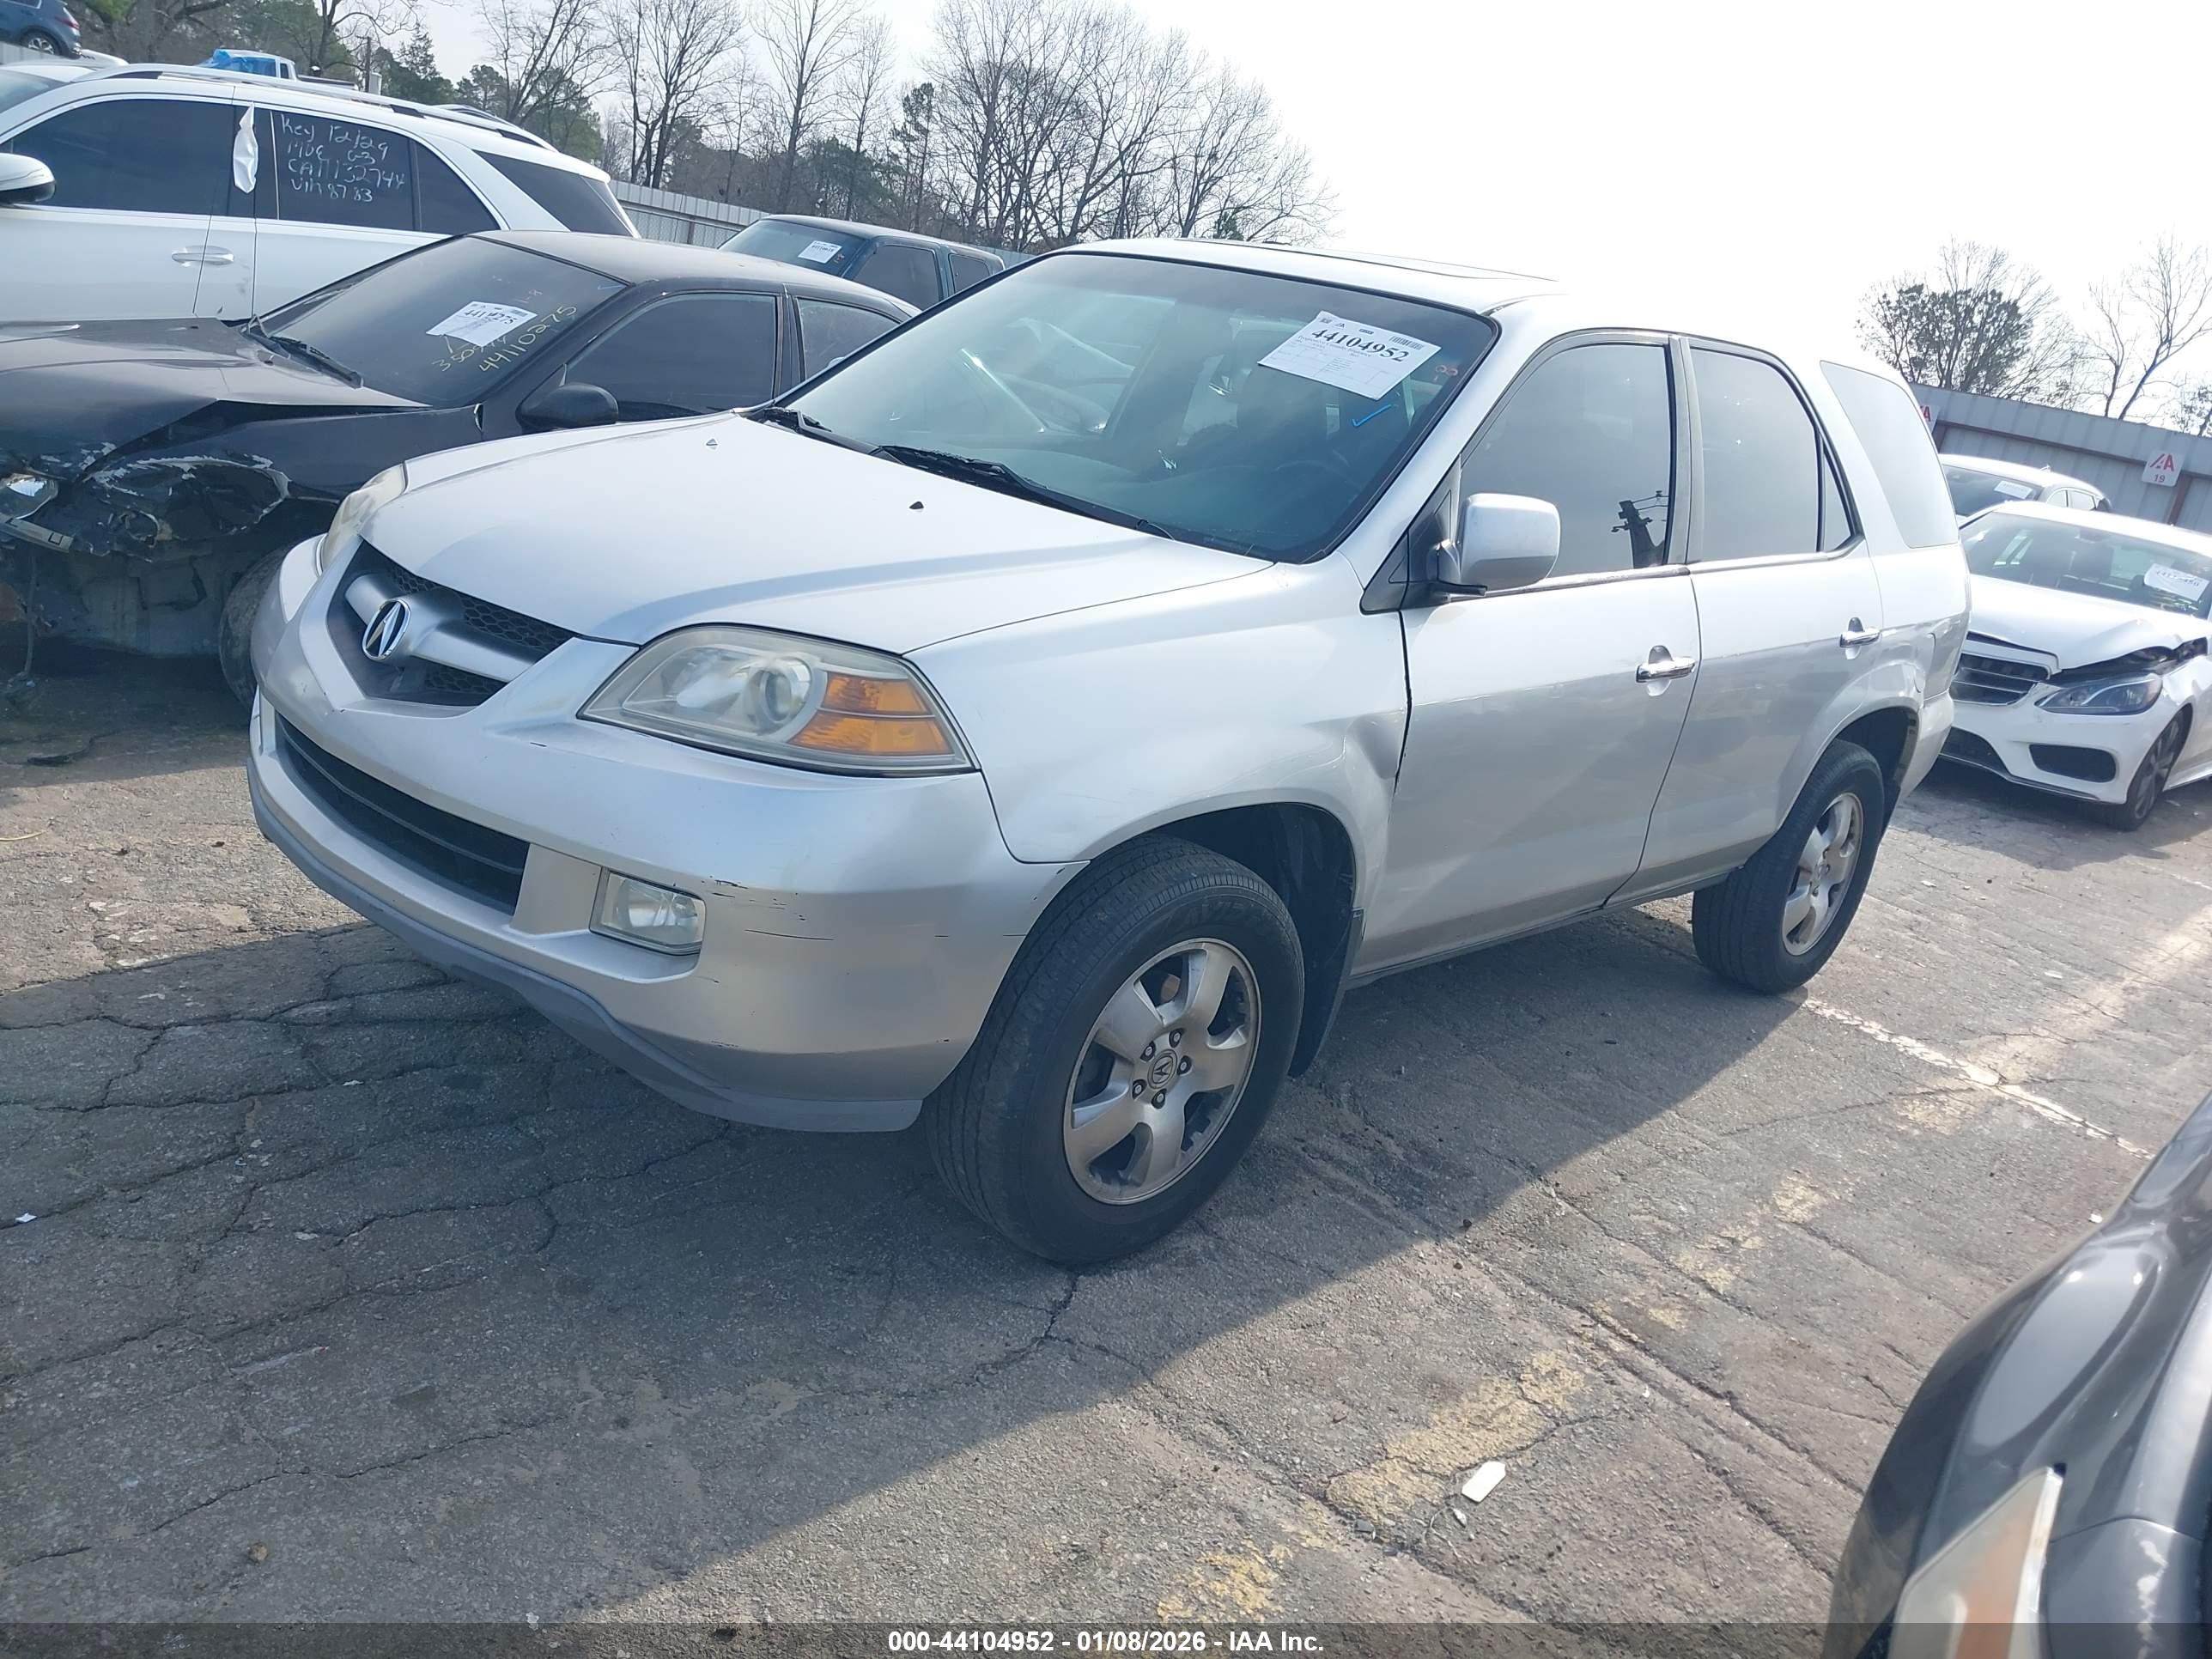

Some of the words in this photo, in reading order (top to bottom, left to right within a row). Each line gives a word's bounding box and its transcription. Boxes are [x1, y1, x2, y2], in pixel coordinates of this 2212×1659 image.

[479, 306, 577, 372] 44110275
[1311, 329, 1409, 362] 44104952
[2154, 474, 2166, 483] 19
